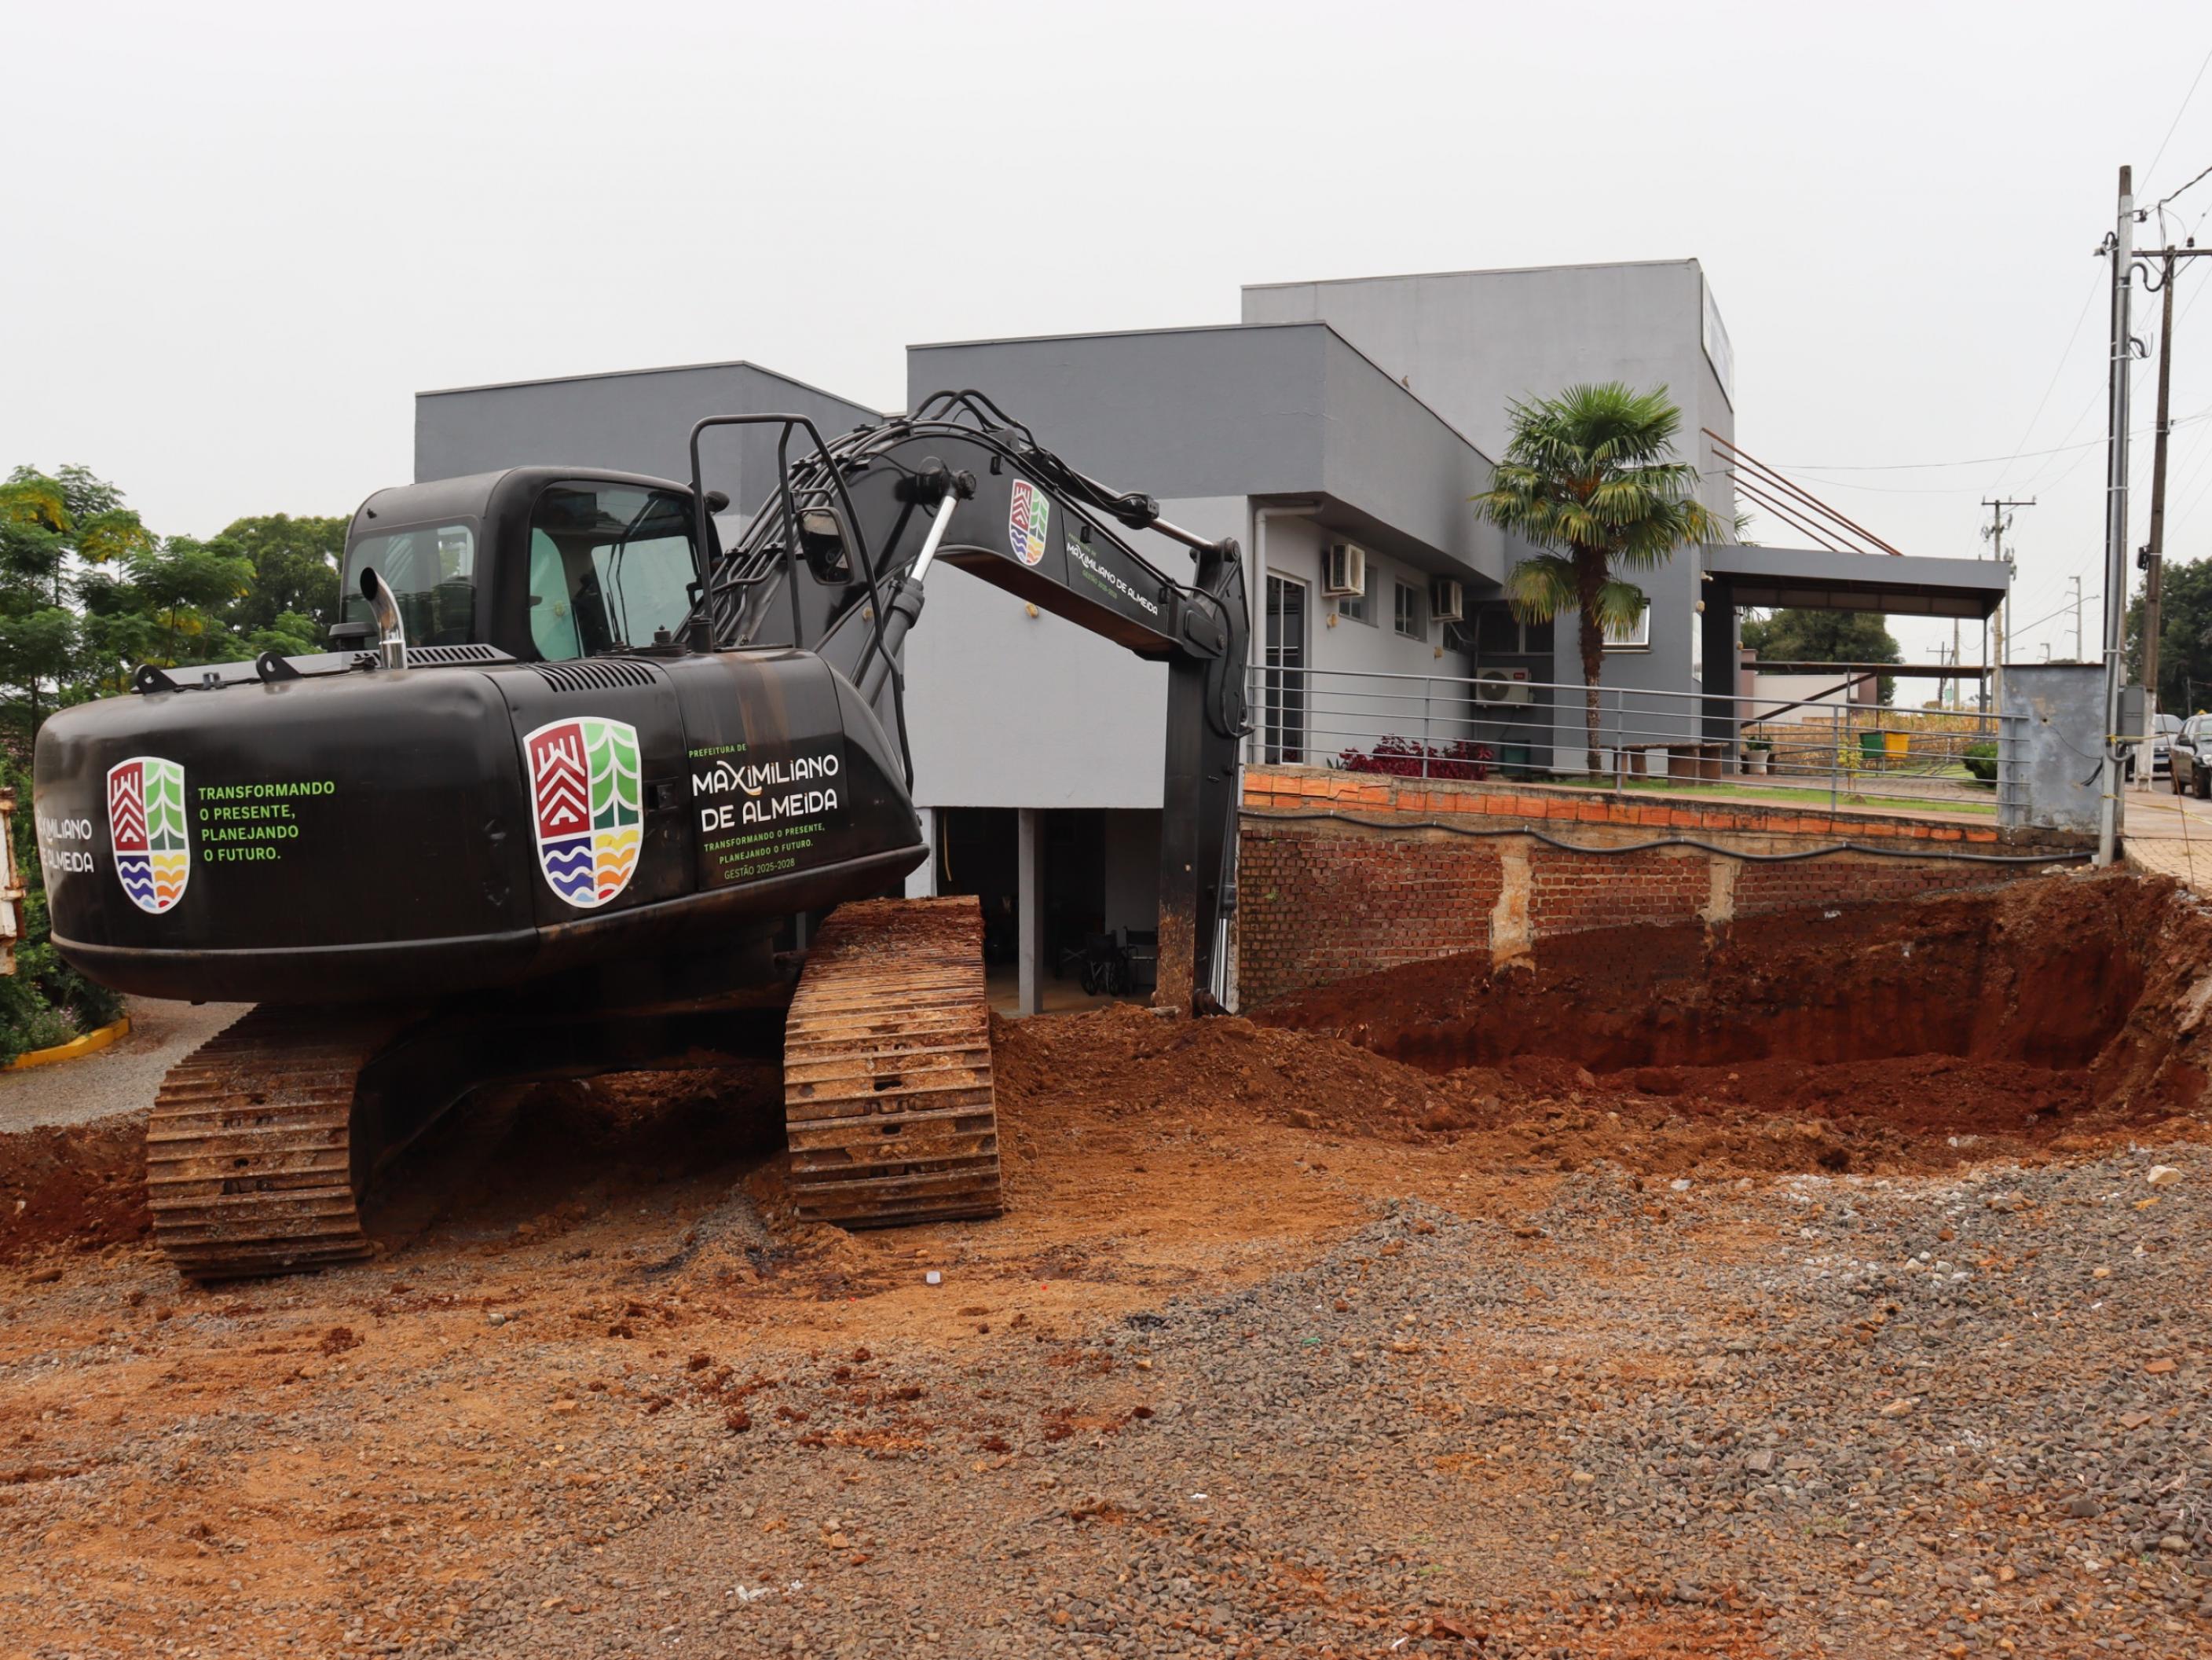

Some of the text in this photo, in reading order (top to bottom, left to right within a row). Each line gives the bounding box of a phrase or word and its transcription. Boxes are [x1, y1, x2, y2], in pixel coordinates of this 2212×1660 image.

[1067, 542, 1116, 584] MAXIMILIANO
[1116, 578, 1127, 594] DE
[1127, 588, 1158, 616] ALMEIDA
[688, 743, 747, 758] PREFEITURA DE
[691, 754, 839, 797] MAXIMILIANO
[198, 781, 335, 801] TRANSFORMANDO
[200, 804, 295, 821] O PRESENTE,
[701, 788, 838, 833] DE ALMEIDA
[201, 825, 298, 841] PLANEJANDO
[704, 823, 826, 852] TRANSFORMANDO O PRESENTE,
[203, 847, 281, 862] O FUTURO.
[719, 838, 814, 865] PLANEJANDO O FUTURO.
[724, 858, 796, 880] GESTÃO 2025-2028
